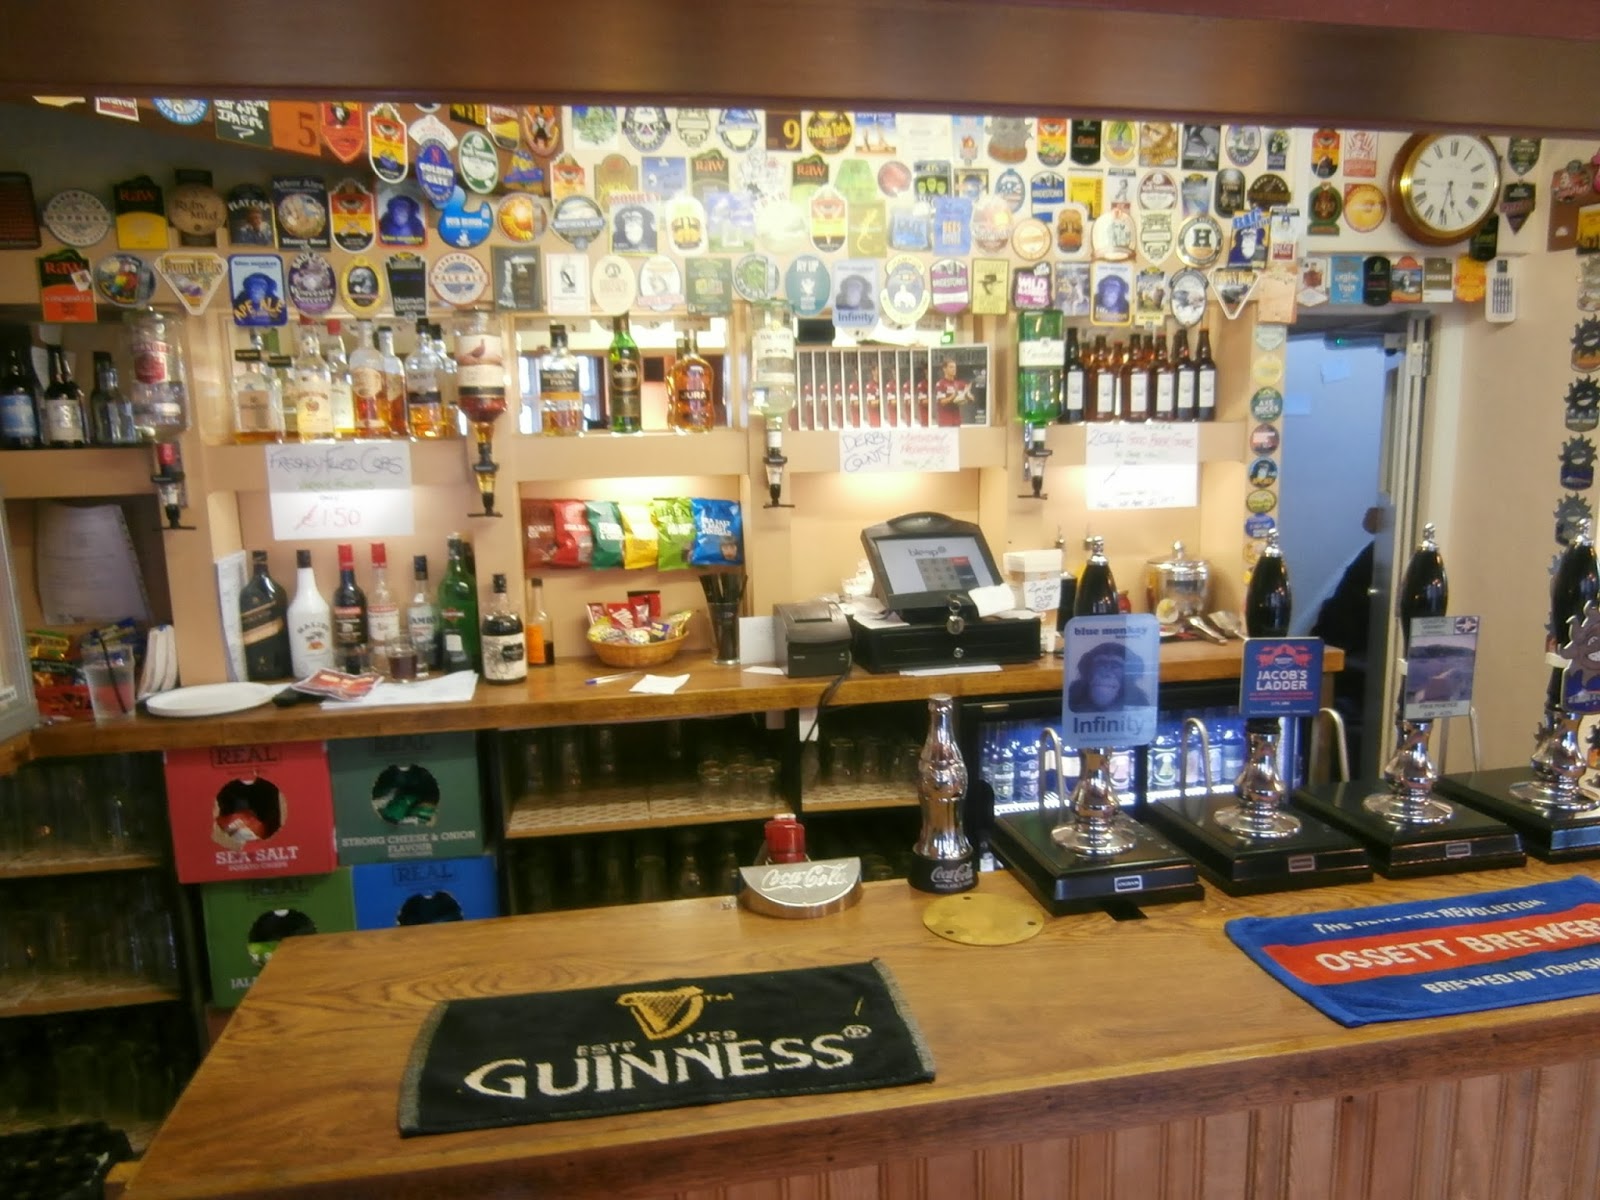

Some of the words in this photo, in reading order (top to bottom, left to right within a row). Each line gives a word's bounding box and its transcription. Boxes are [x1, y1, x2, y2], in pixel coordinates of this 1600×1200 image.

[298, 111, 317, 147] 5
[783, 119, 800, 148] 9
[1193, 229, 1211, 247] H
[838, 312, 875, 324] Infinity
[681, 391, 707, 400] JURA
[1074, 626, 1099, 637] blue
[1101, 625, 1148, 638] monkey
[1256, 669, 1308, 681] JACOB'S
[1255, 681, 1308, 692] LADDER
[1073, 716, 1145, 735] Infinity
[215, 746, 279, 765] REAL
[342, 836, 386, 848] STRONG
[387, 833, 429, 844] CHEESE
[441, 830, 476, 842] ONION
[215, 850, 251, 865] SEA
[255, 845, 299, 861] SALT
[760, 864, 849, 892] Coca-Cola
[1436, 899, 1548, 919] REVOLUTION
[1314, 938, 1457, 973] OSSETT
[1455, 916, 1600, 955] BREWER
[1421, 970, 1509, 995] BREWED
[1511, 968, 1536, 982] IN
[686, 1030, 738, 1044] 1759
[463, 1032, 855, 1100] GUINNESS
